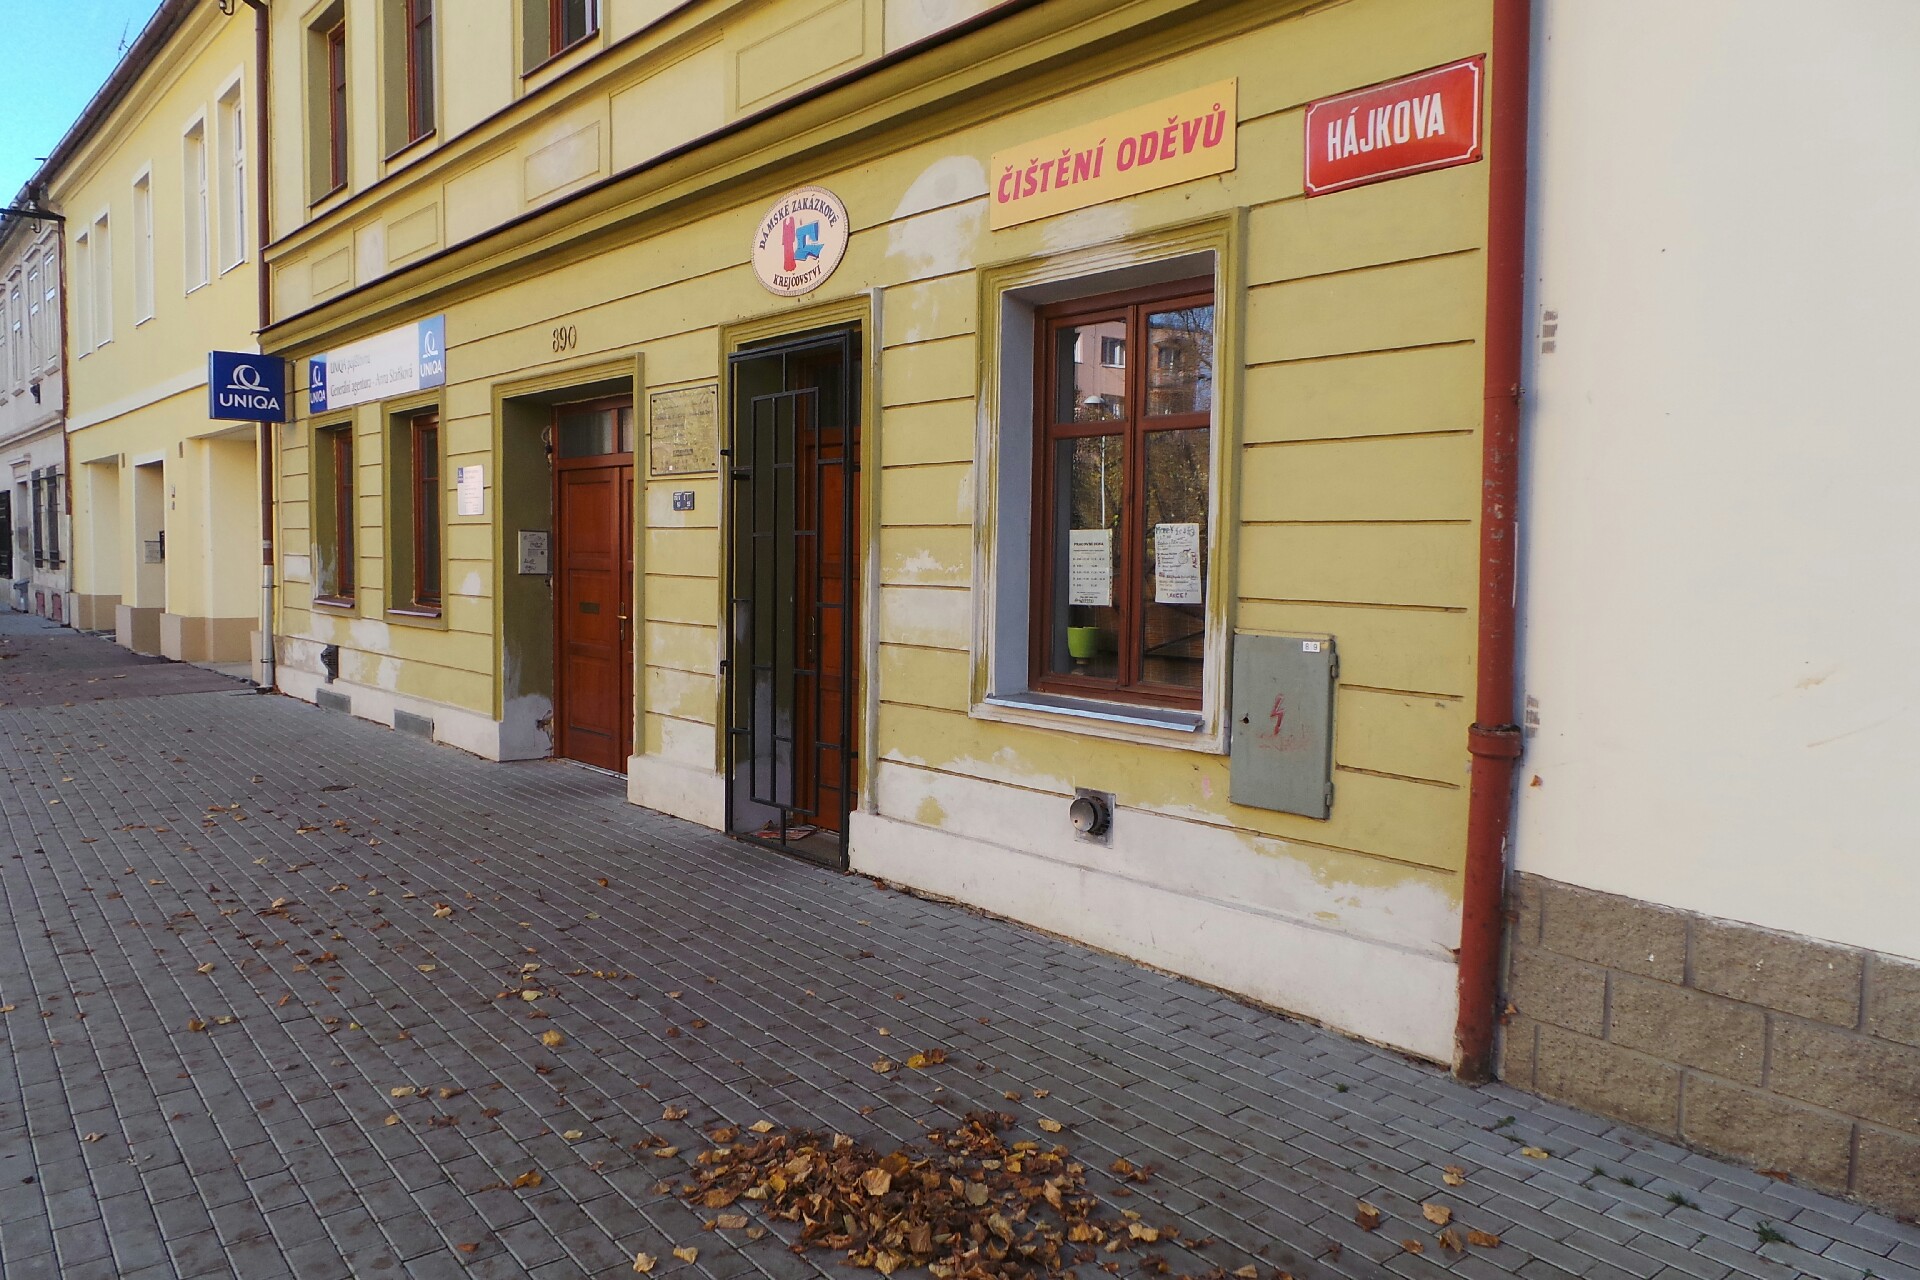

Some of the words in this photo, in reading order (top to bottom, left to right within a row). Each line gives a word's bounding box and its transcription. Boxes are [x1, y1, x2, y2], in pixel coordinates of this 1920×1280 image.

[1327, 92, 1445, 162] HÁJKOVA
[997, 137, 1107, 204] ČIŠTĚNÍ
[1116, 102, 1227, 172] ODĚVŮ
[759, 200, 790, 250] DÁMSKÉ
[792, 193, 840, 228] ZAKÁZKOVÉ
[773, 260, 822, 290] KREJČOVSTVÍ
[552, 324, 577, 352] 890
[420, 359, 443, 378] UNIQA
[219, 393, 280, 411] UNIQA
[310, 389, 326, 404] UNIQA
